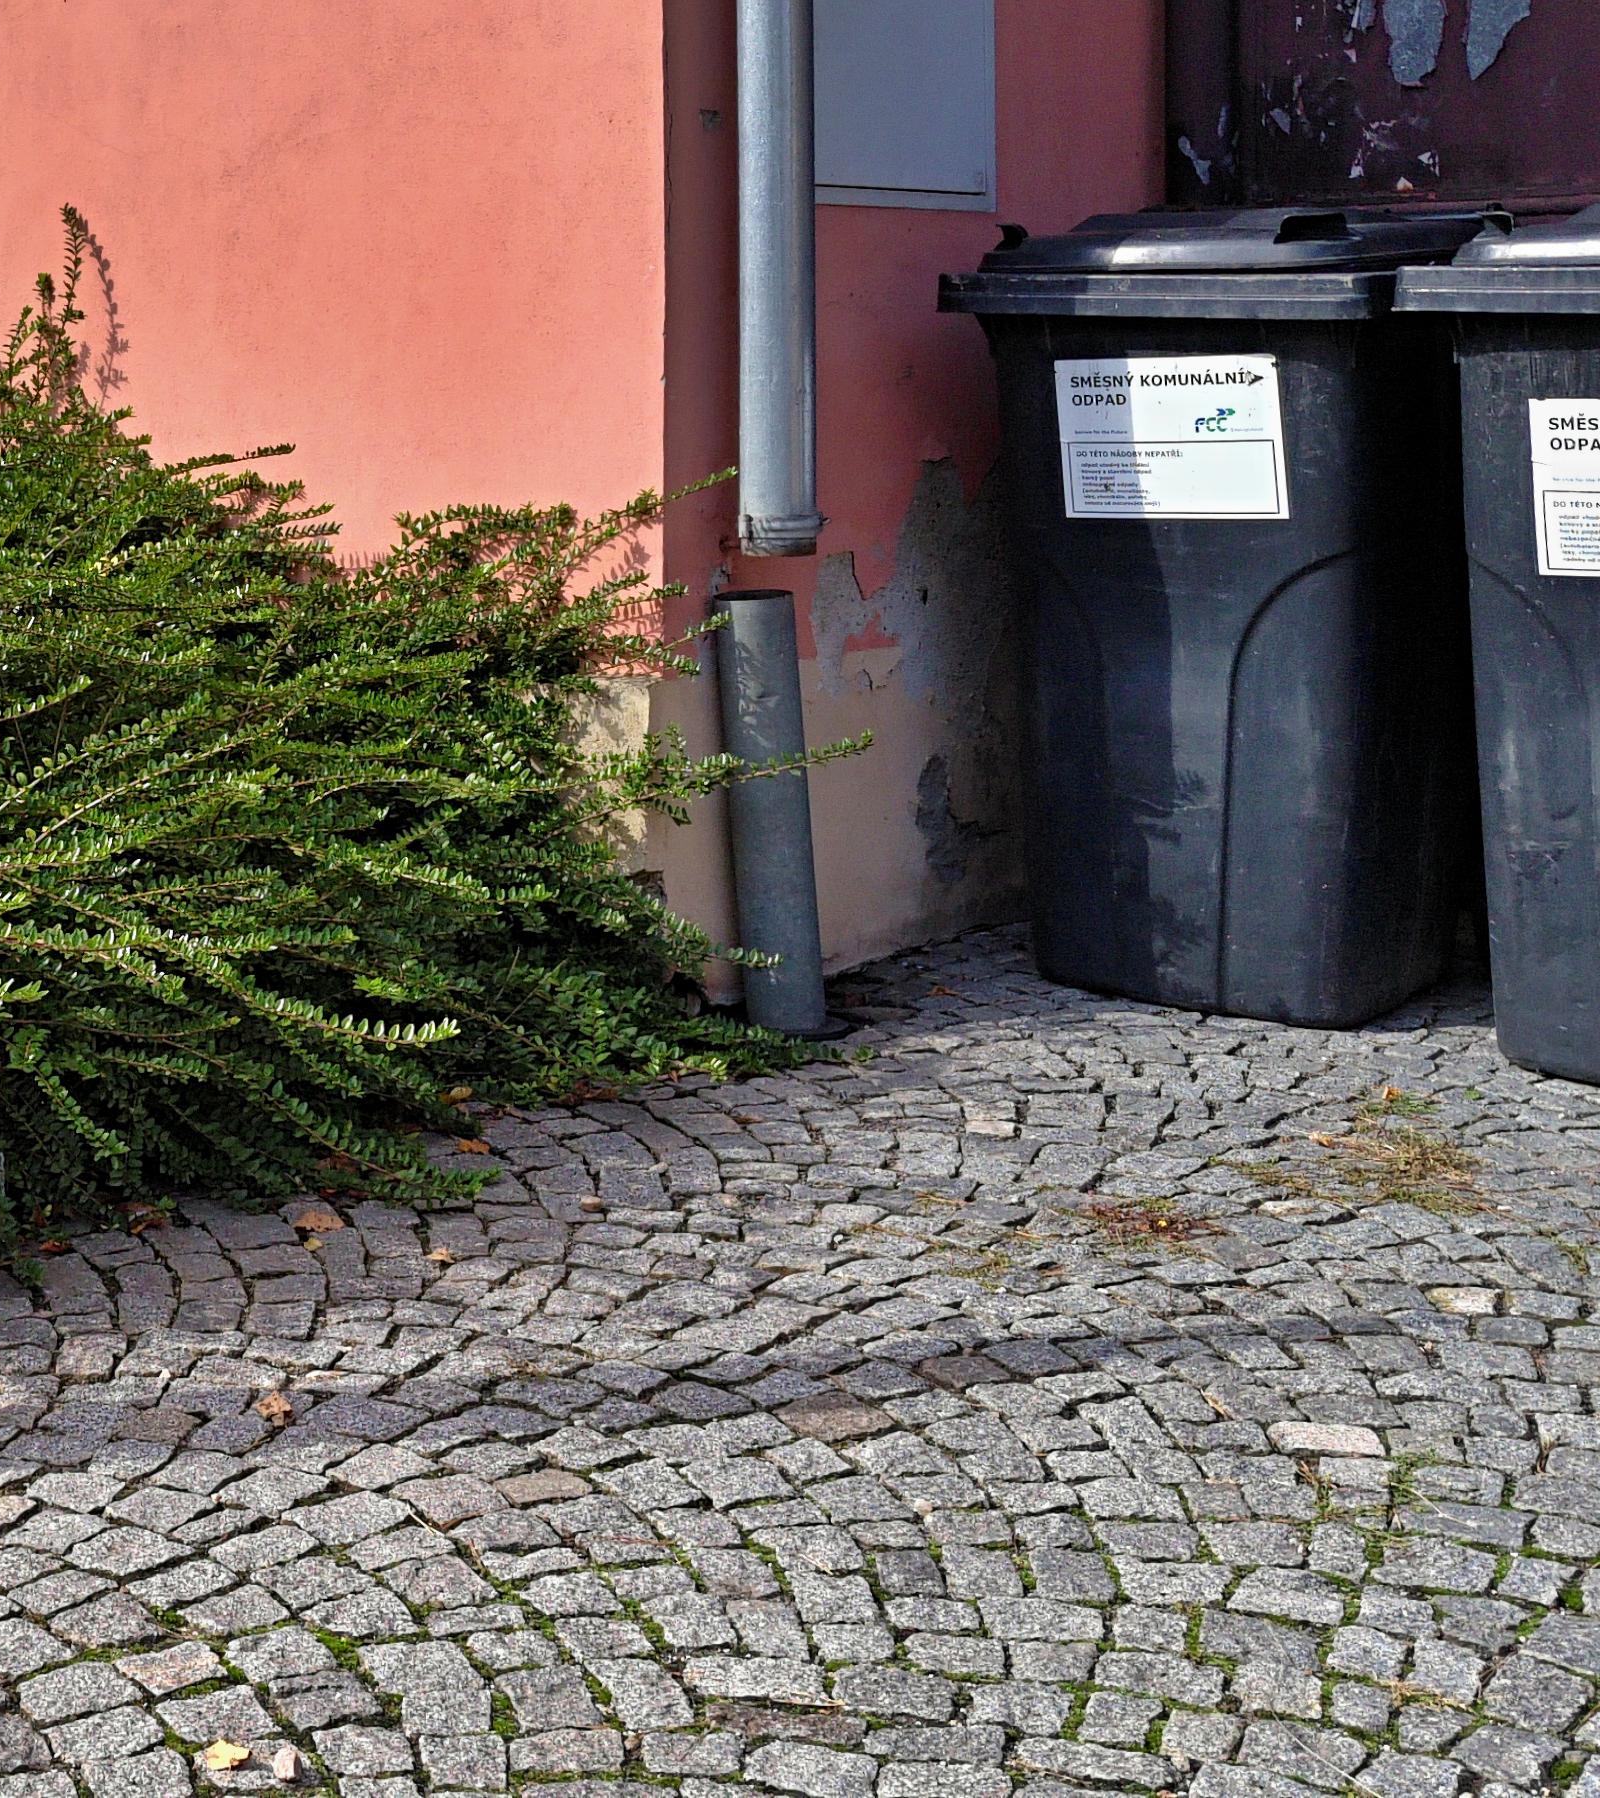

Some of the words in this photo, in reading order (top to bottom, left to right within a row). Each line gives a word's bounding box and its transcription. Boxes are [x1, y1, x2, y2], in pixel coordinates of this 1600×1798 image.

[1070, 371, 1134, 388] SMĚSNÝ
[1140, 367, 1247, 387] KOMUNÁLNÍ
[1072, 393, 1127, 406] ODPAD
[1194, 416, 1228, 433] FCC
[1076, 450, 1088, 458] DO
[1090, 449, 1109, 458] TÉTO
[1110, 448, 1143, 458] NÁDOBY
[1569, 499, 1593, 509] TÉTO
